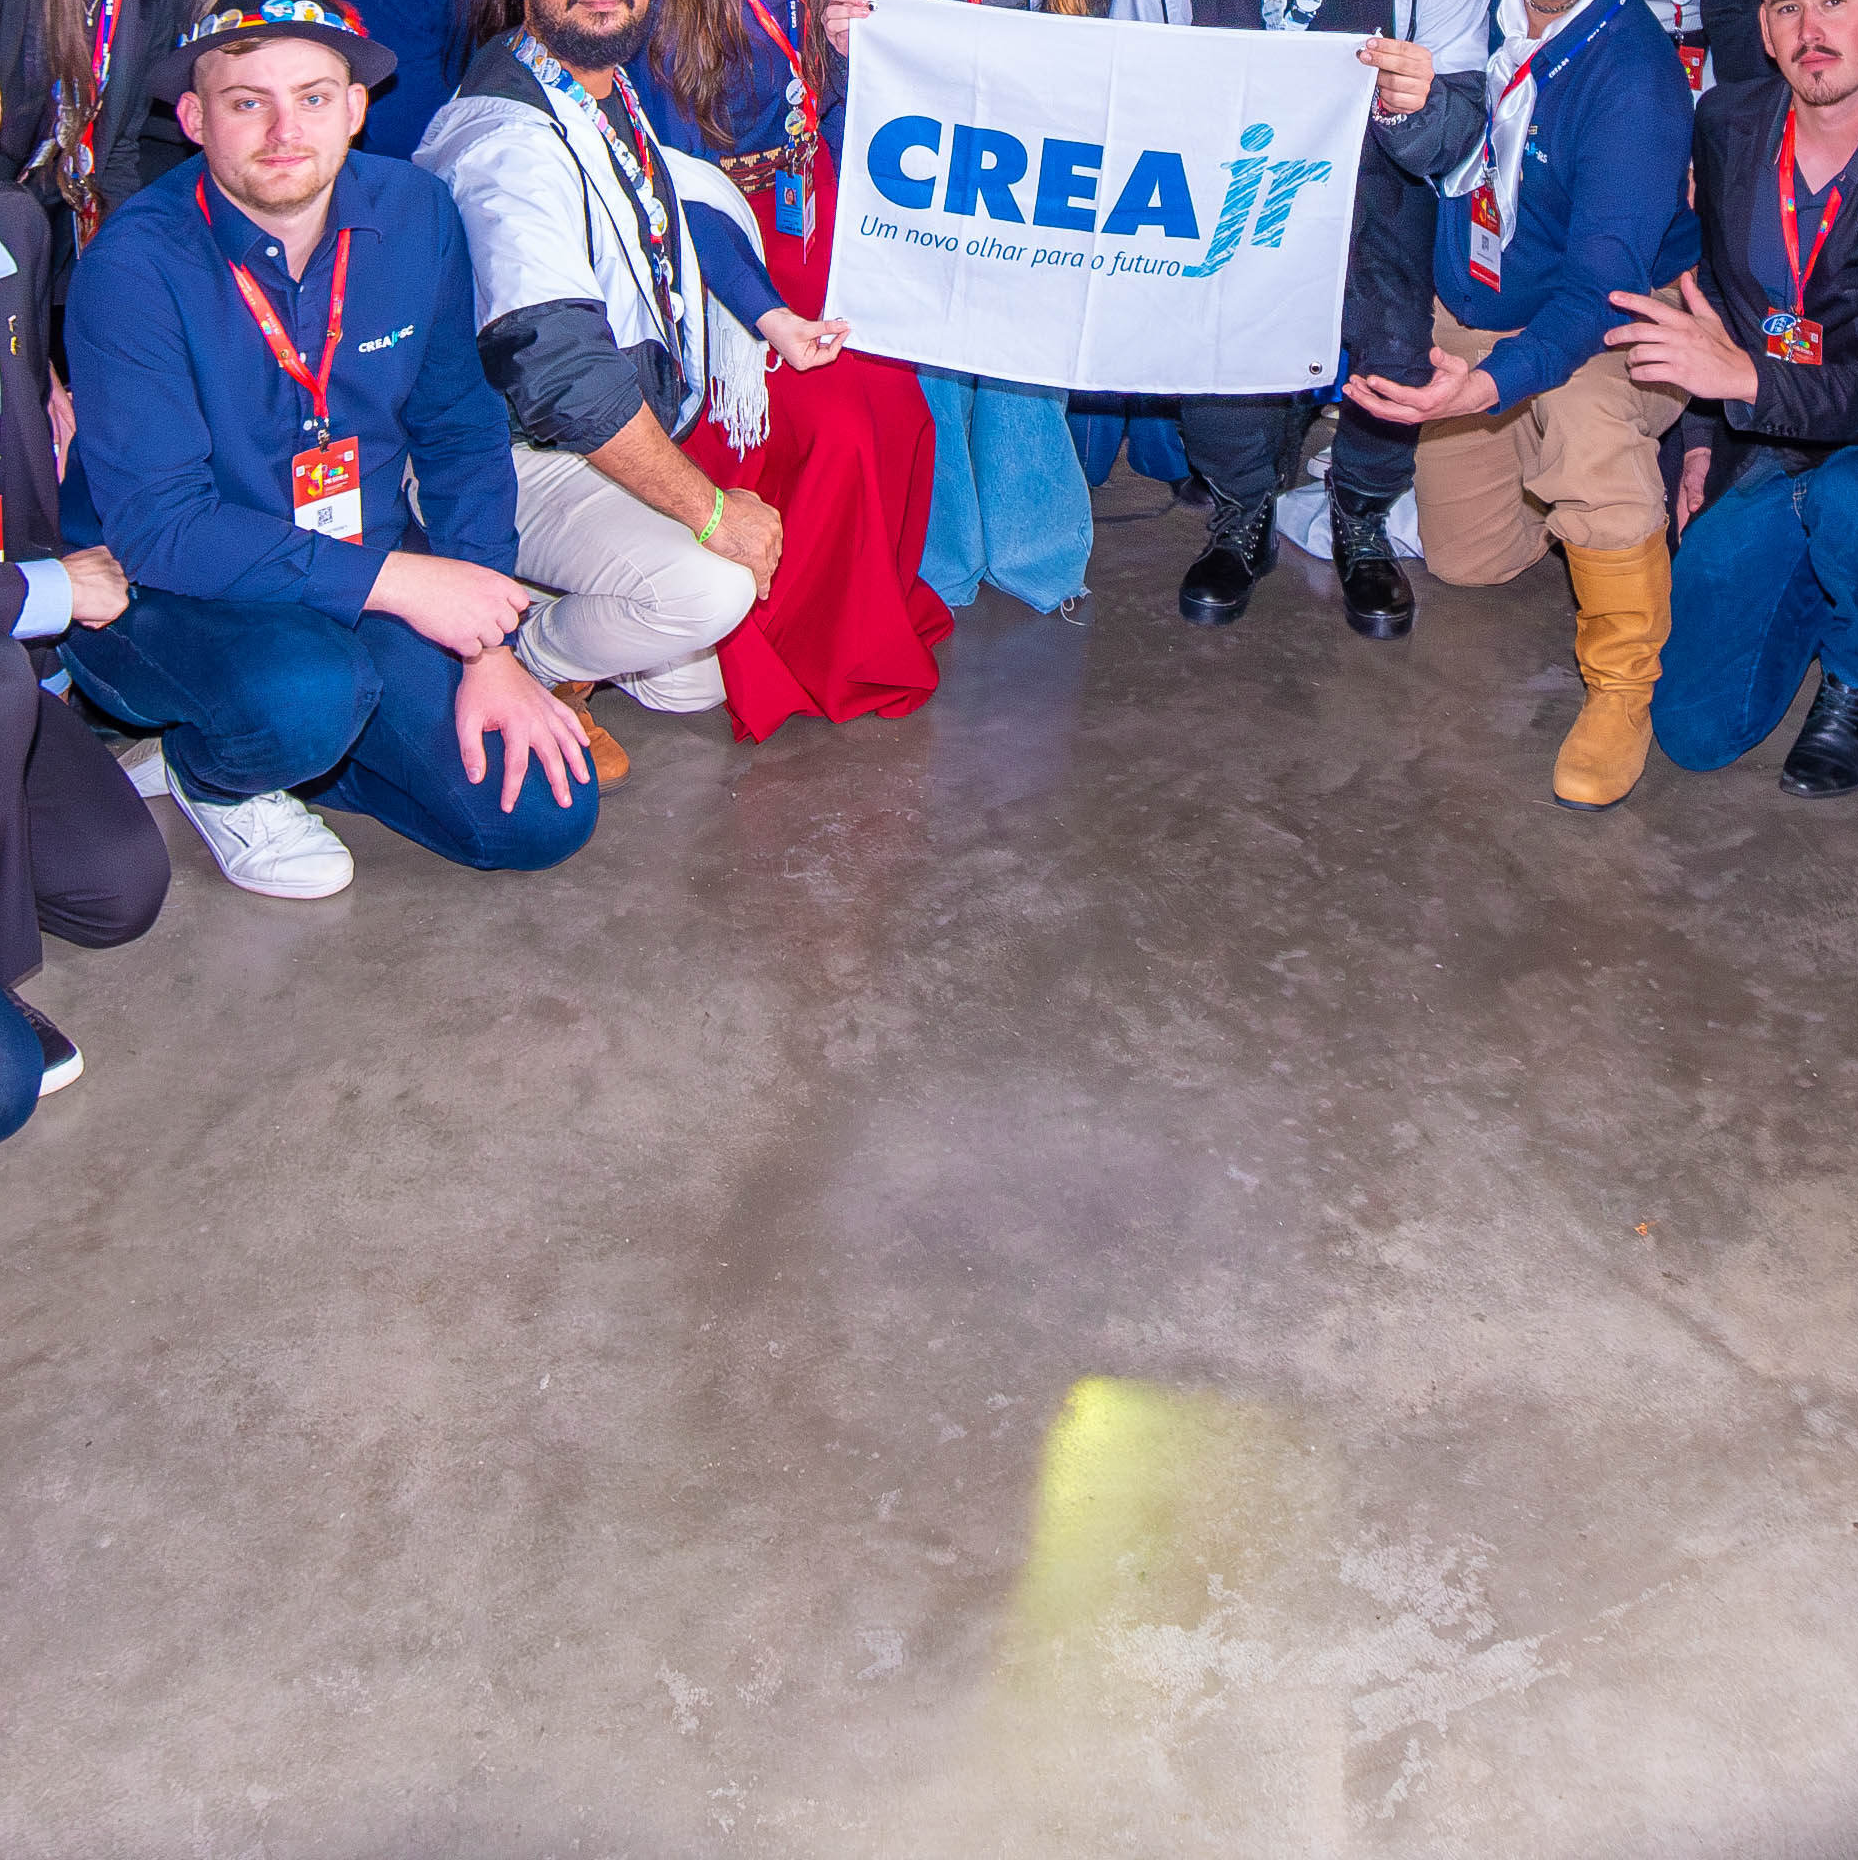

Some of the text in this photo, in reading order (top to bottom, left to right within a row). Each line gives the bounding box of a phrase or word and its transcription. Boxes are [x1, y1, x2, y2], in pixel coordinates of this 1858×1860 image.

[860, 214, 1182, 278] Um novo olhar para o futuro
[866, 114, 1334, 279] CREA jr
